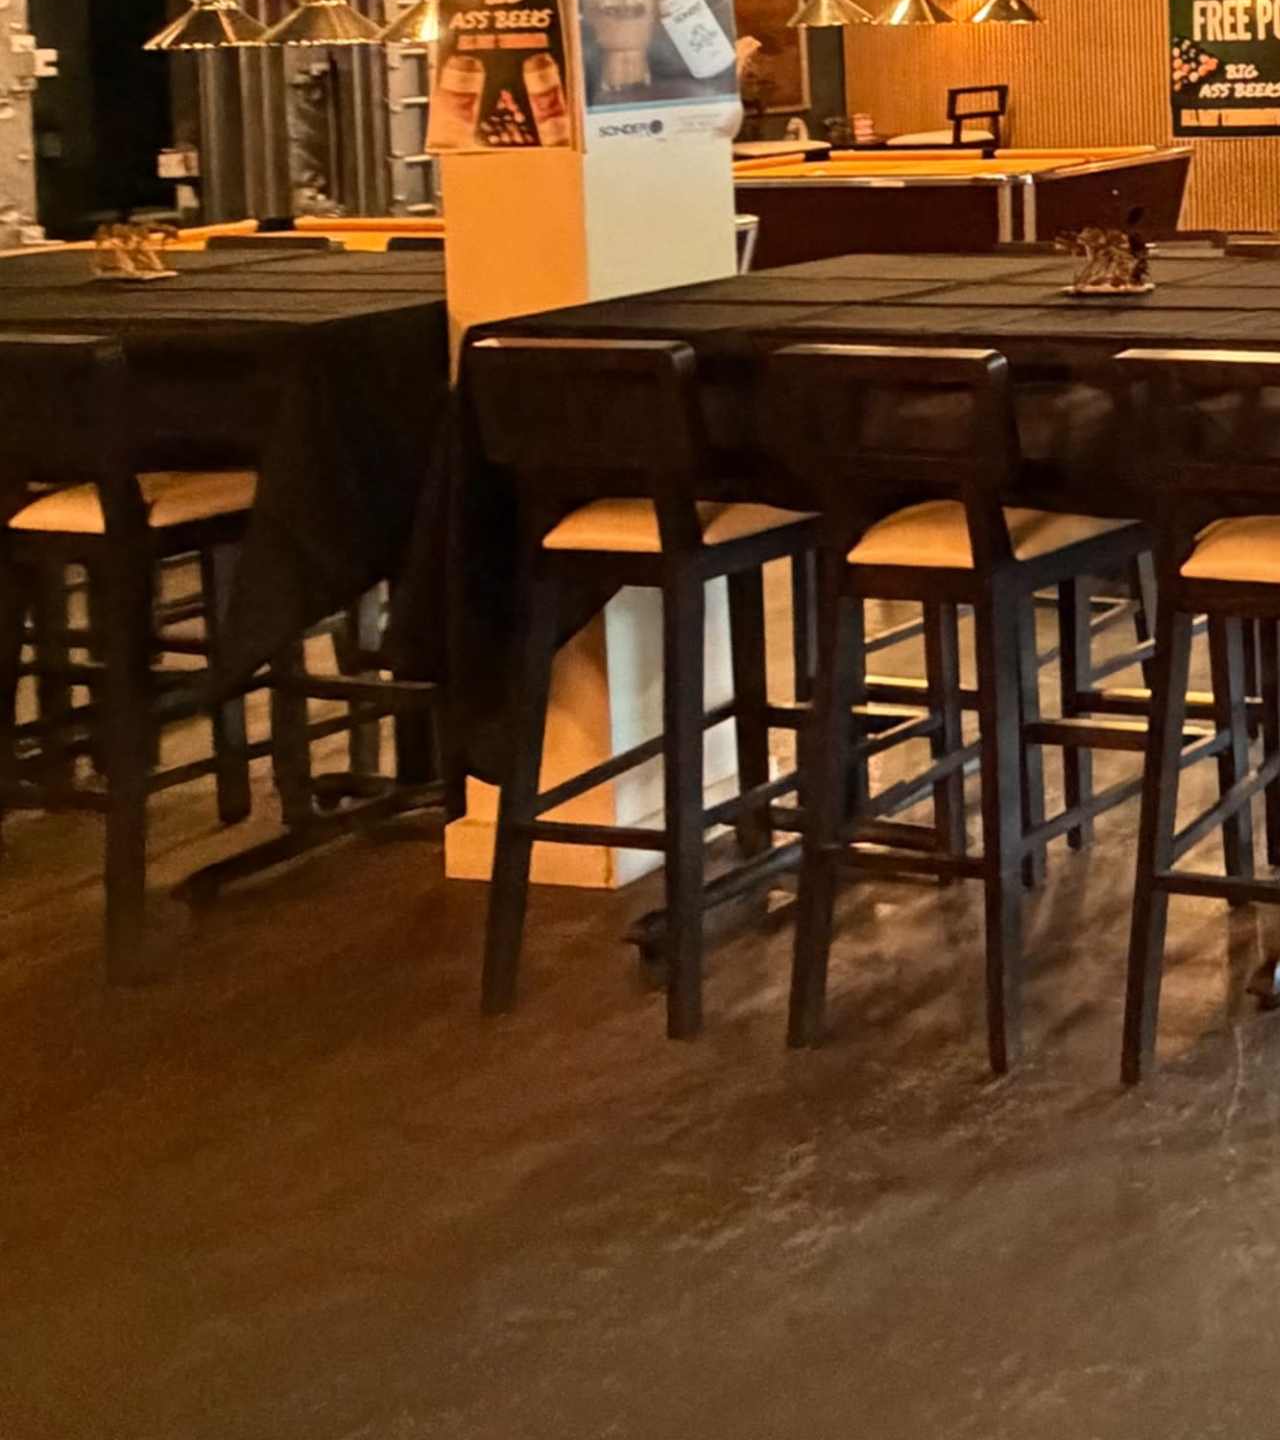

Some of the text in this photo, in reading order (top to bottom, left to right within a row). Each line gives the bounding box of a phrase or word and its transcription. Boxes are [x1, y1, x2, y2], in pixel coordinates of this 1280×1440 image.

[449, 8, 554, 30] ASS BEERS
[1224, 63, 1260, 80] BIG
[1198, 83, 1233, 99] ASS
